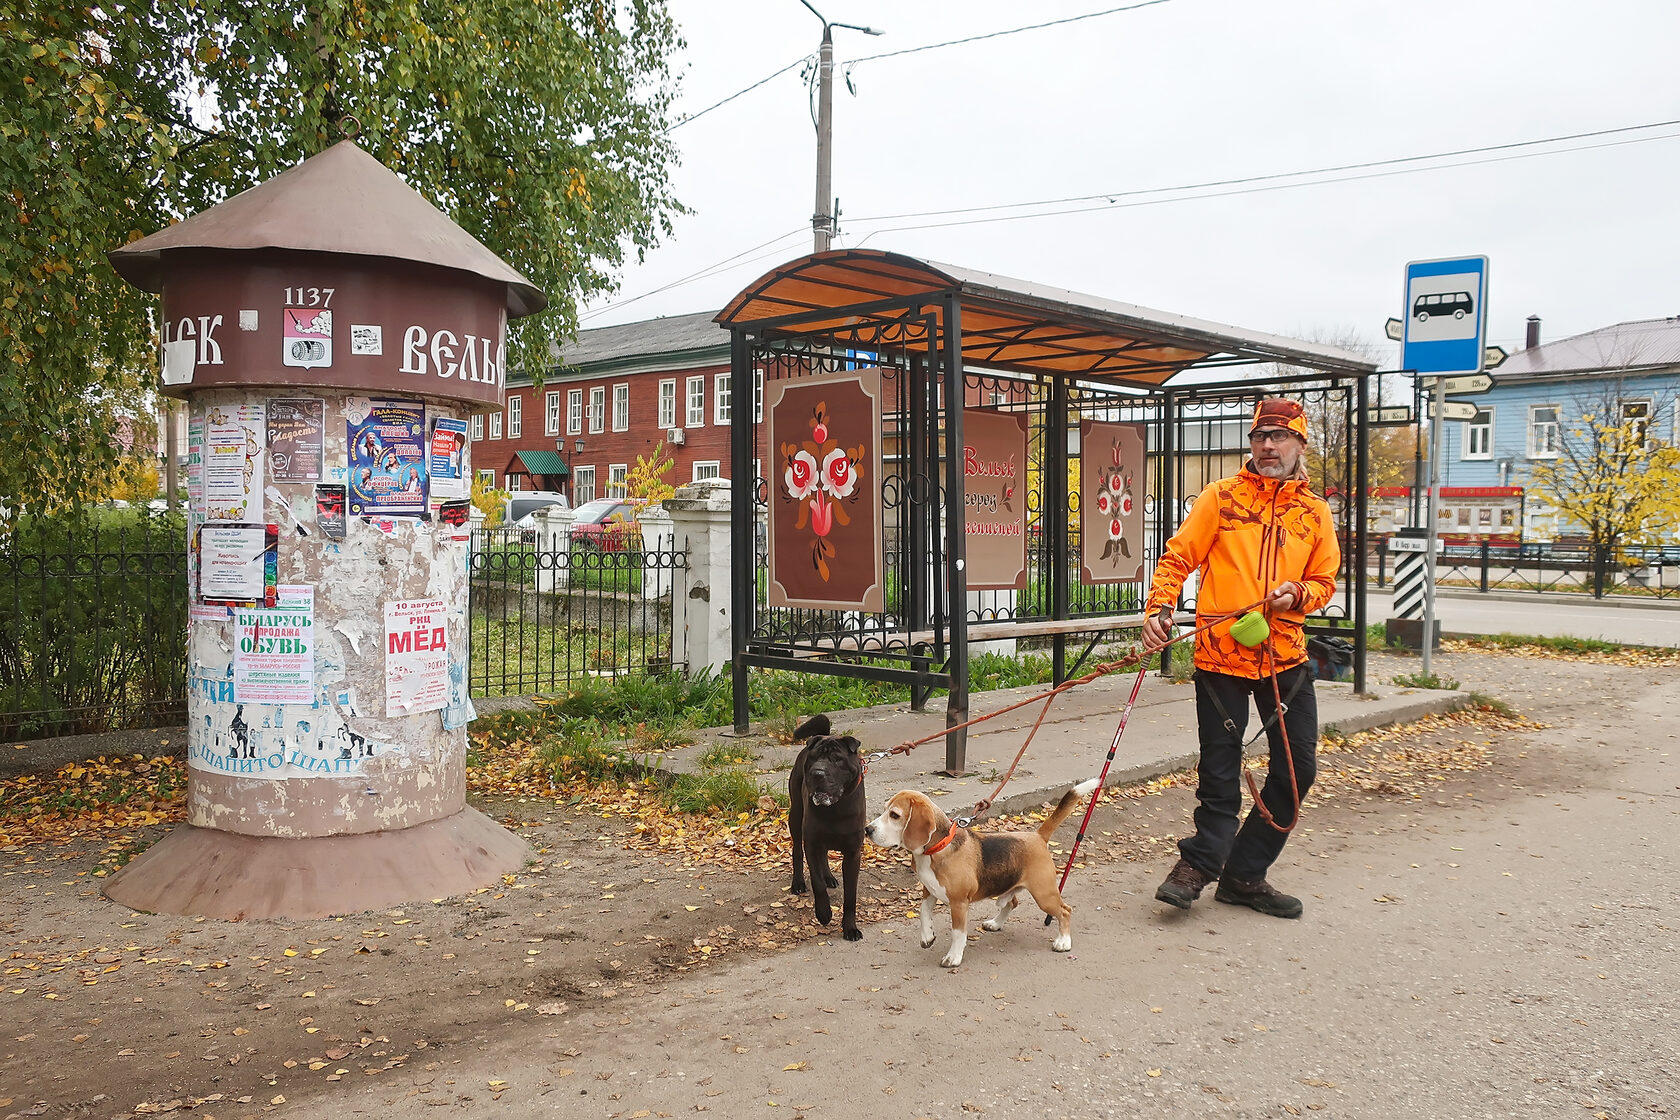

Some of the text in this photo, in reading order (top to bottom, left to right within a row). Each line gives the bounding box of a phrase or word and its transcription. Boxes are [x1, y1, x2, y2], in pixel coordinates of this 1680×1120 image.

[284, 287, 335, 308] 1137
[963, 445, 1016, 479] Вельск
[965, 492, 998, 514] город
[395, 600, 444, 610] 10 августа
[243, 627, 301, 638] РАПРОДАЖА
[388, 625, 447, 655] МЁД
[200, 744, 284, 773] ШАПИТО
